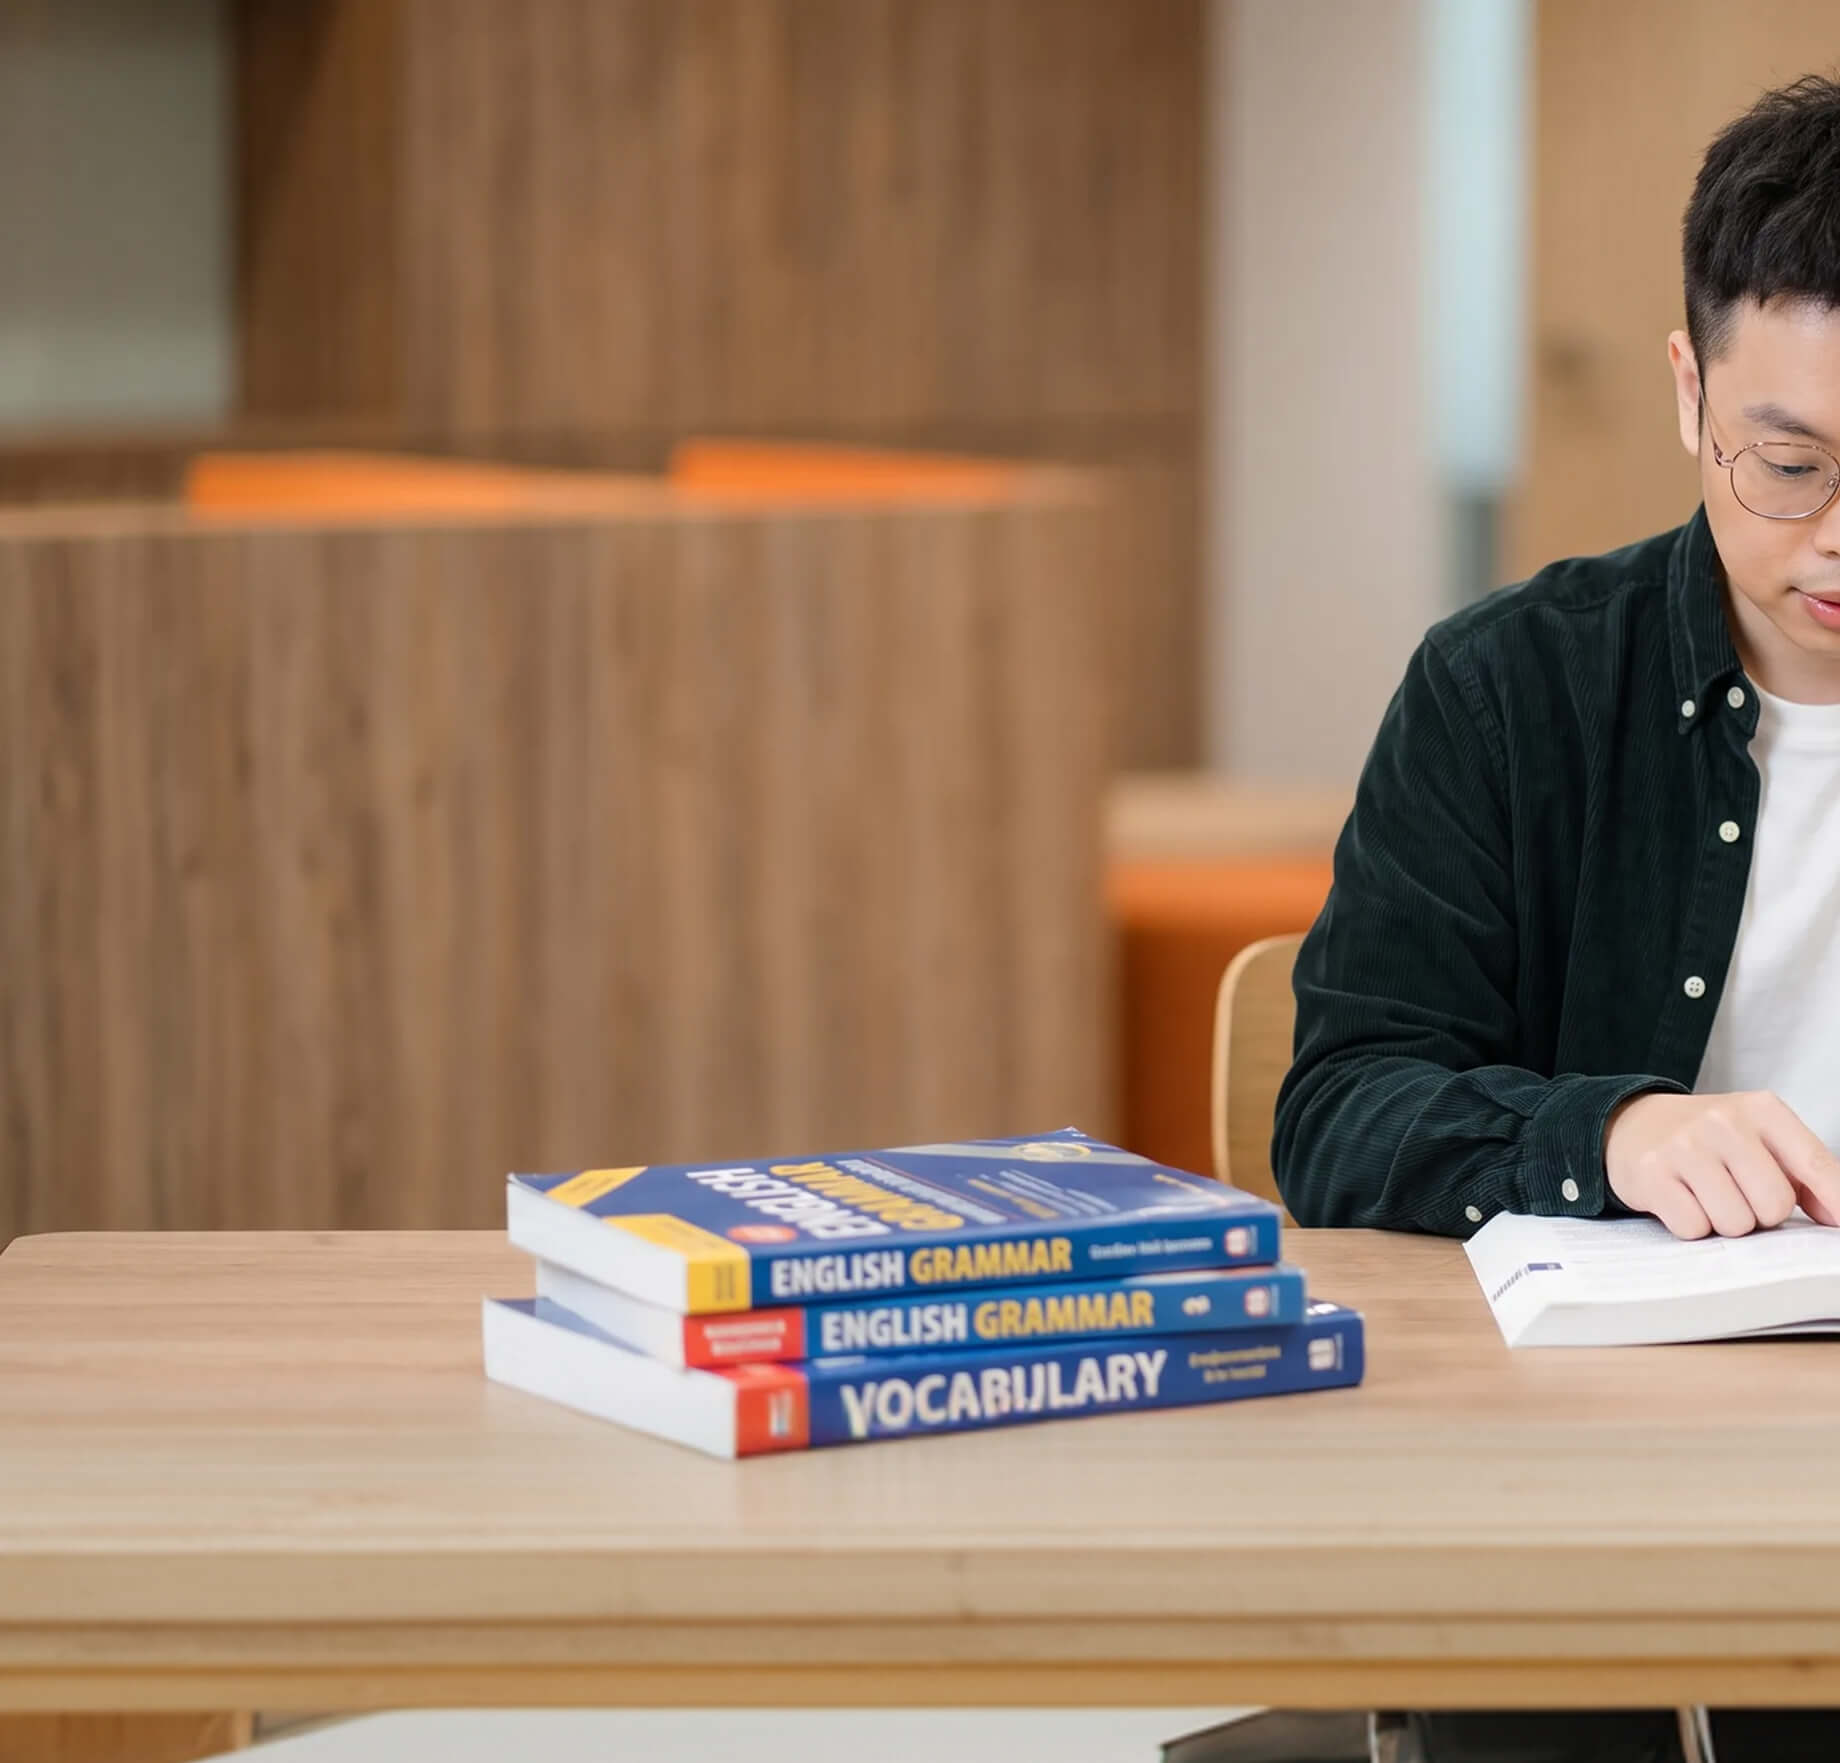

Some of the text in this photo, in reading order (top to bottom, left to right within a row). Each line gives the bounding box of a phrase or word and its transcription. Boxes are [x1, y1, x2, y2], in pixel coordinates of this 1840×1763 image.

[685, 1167, 892, 1240] ENGLISH
[770, 1251, 904, 1297] ENGLISH
[909, 1237, 1072, 1284] GRAMMAR
[821, 1305, 967, 1351] ENGLISH
[973, 1290, 1155, 1338] GRAMMAR
